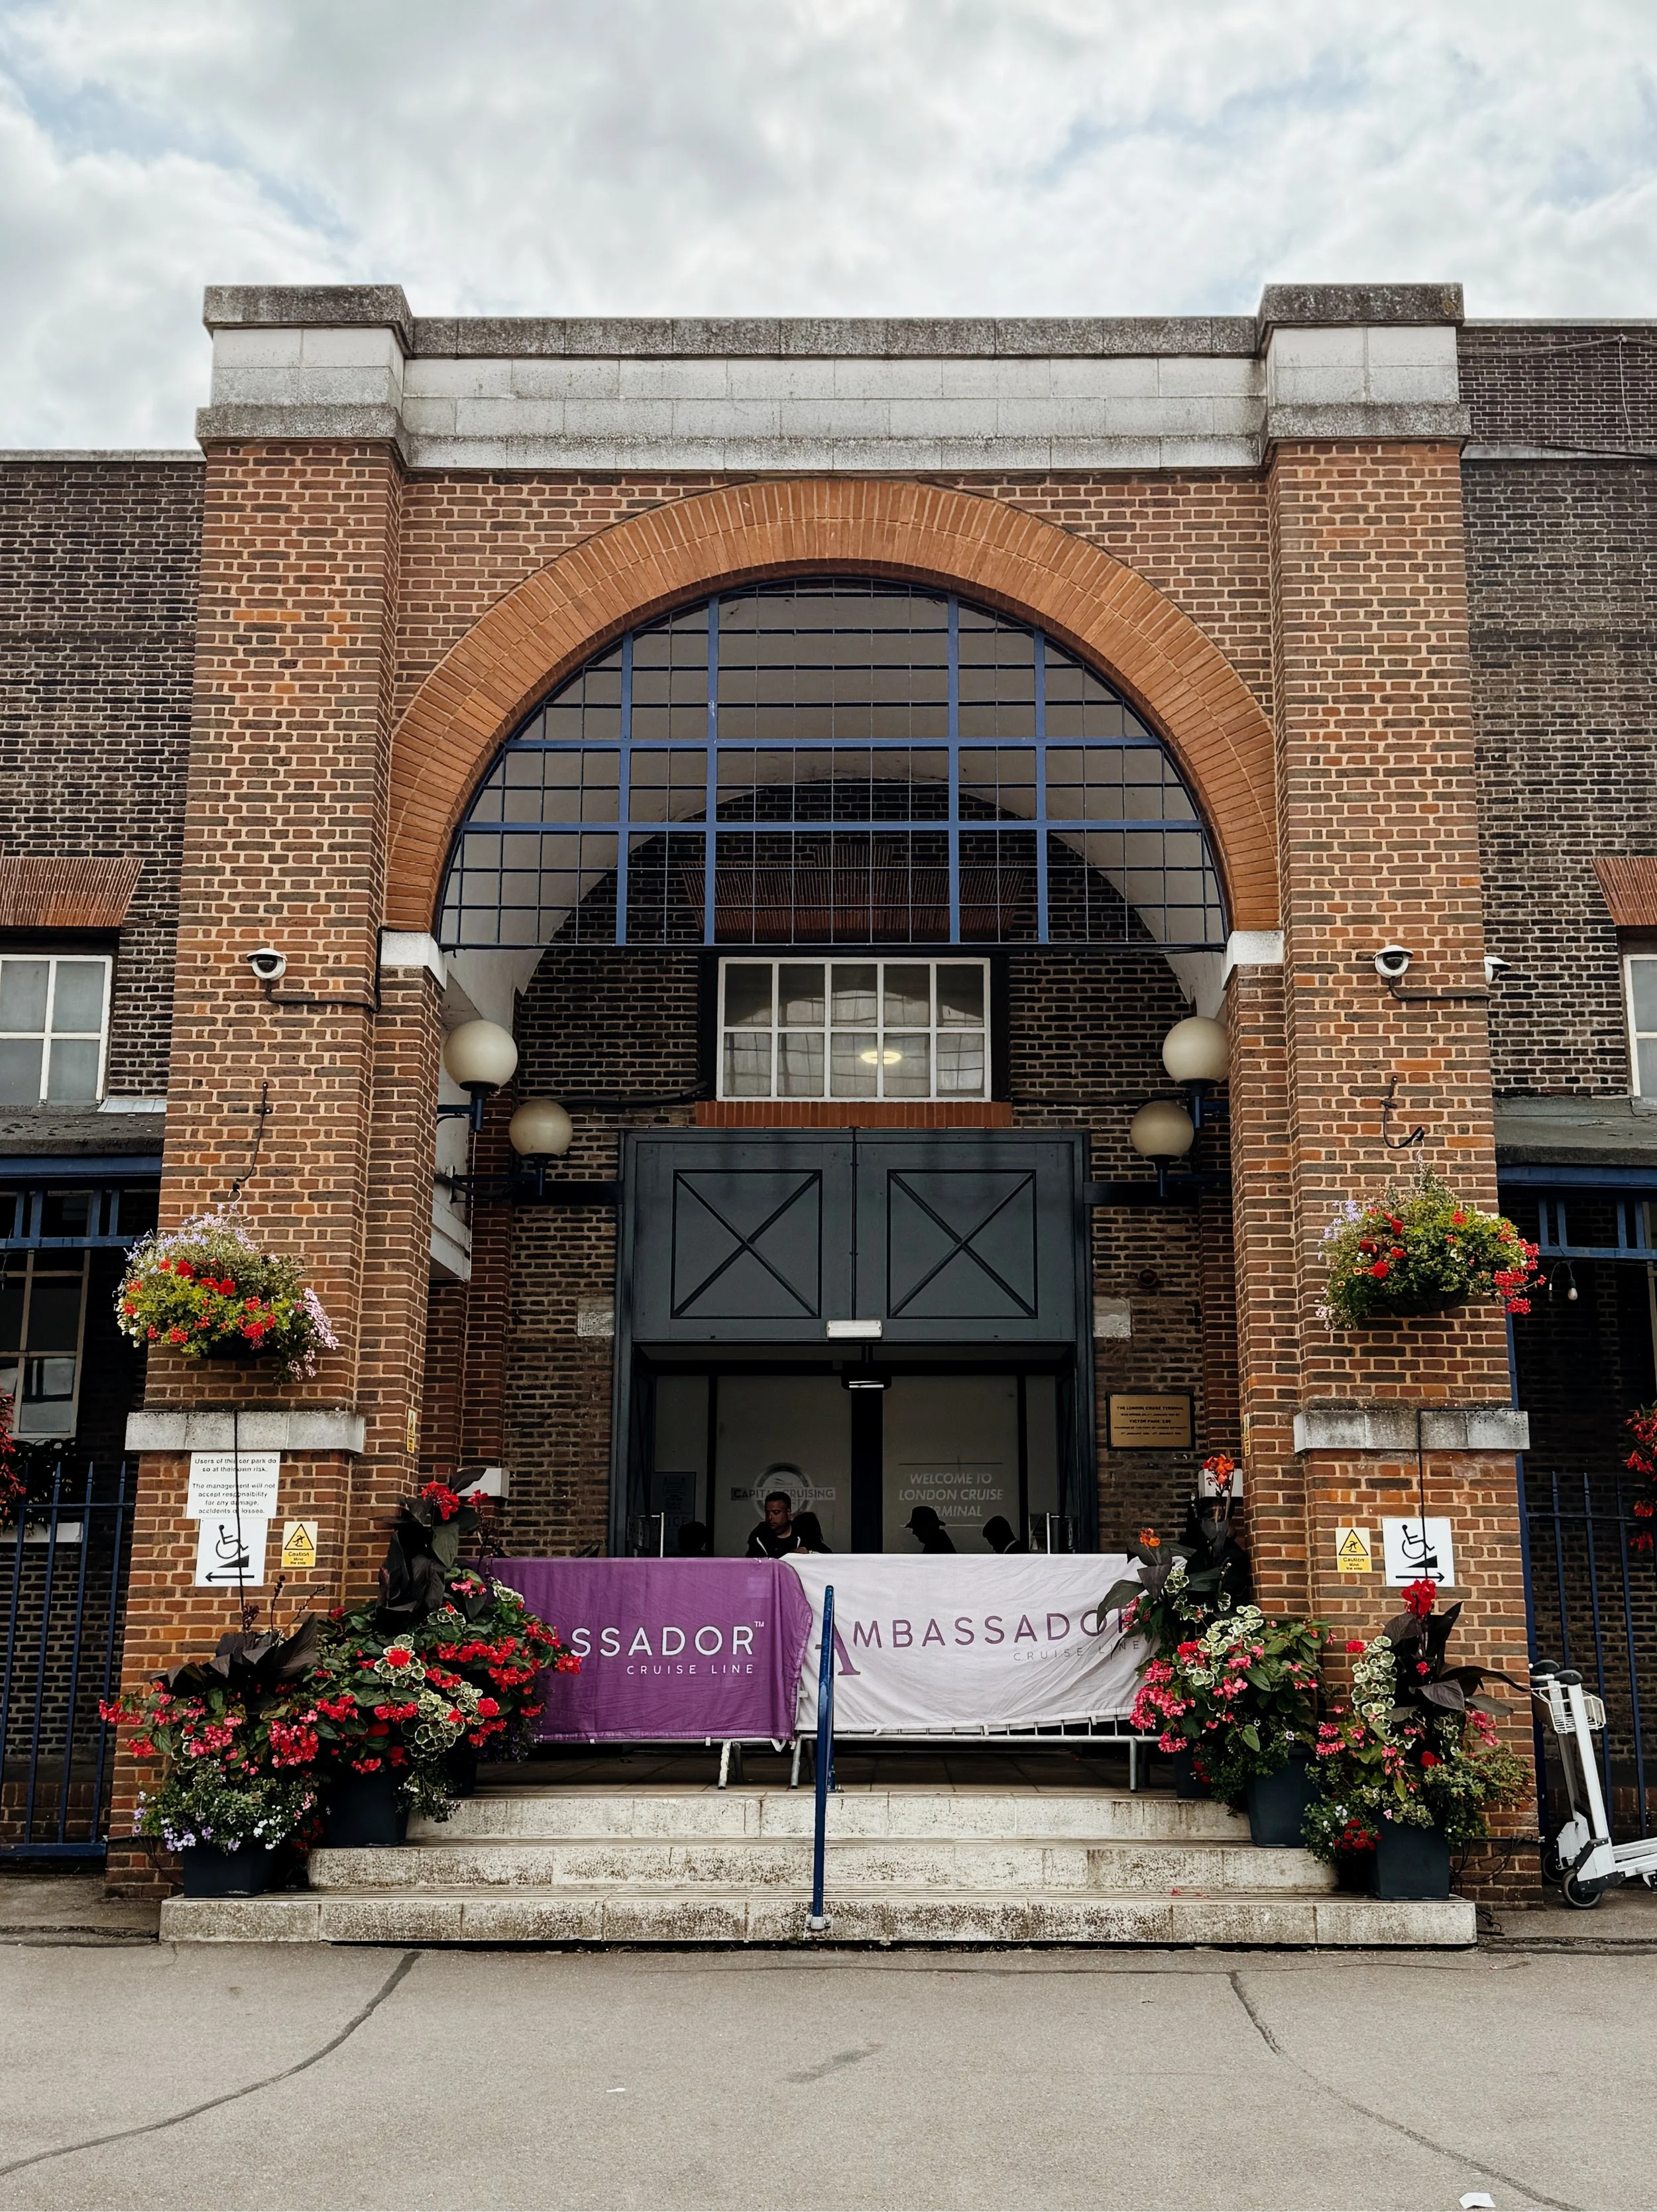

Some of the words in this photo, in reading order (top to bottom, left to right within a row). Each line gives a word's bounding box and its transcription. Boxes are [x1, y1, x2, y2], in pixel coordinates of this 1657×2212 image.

[909, 1472, 973, 1485] WELCOME
[976, 1472, 992, 1484] TO
[733, 1489, 774, 1498] CAPIT
[899, 1489, 957, 1501] LONDON
[960, 1488, 1004, 1501] CRUISE
[929, 1506, 983, 1518] RMINAL
[1013, 1647, 1084, 1662] CRUISE
[1098, 1640, 1140, 1654] LINE
[627, 1664, 697, 1675] CRUISE
[711, 1663, 754, 1675] LINE
